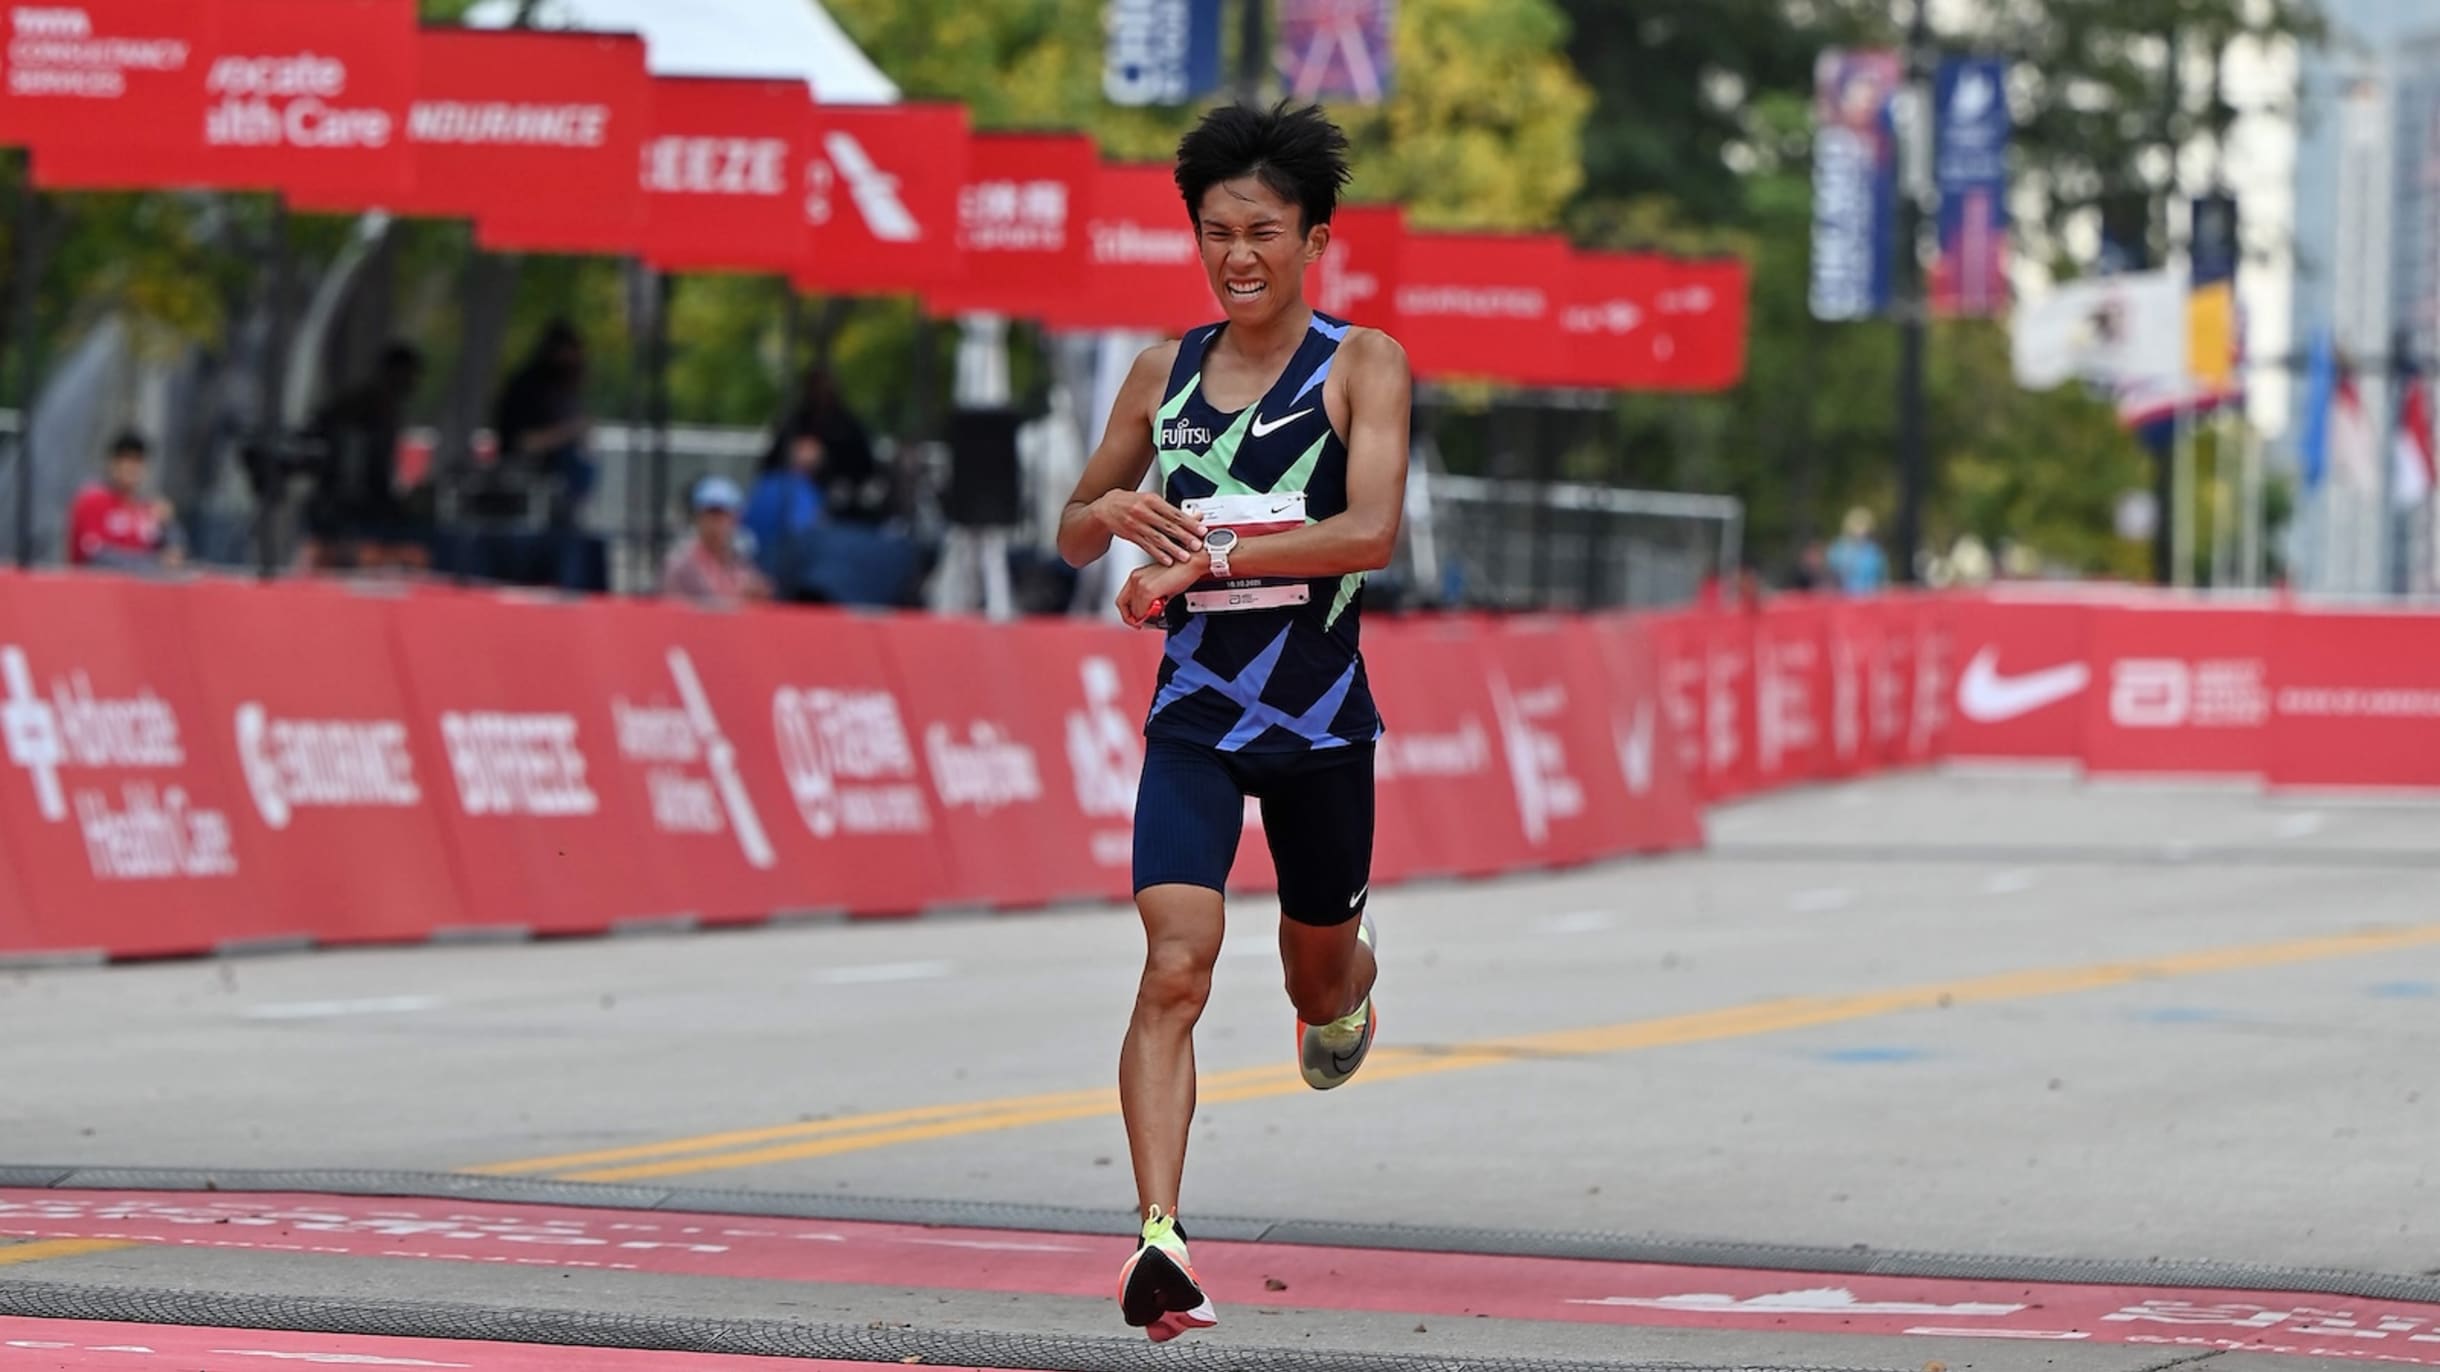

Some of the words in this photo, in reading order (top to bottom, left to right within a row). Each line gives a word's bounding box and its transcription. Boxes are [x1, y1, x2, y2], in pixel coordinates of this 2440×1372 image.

[284, 97, 391, 148] Care
[641, 136, 786, 194] EEZE
[1161, 418, 1211, 449] FUJITSU
